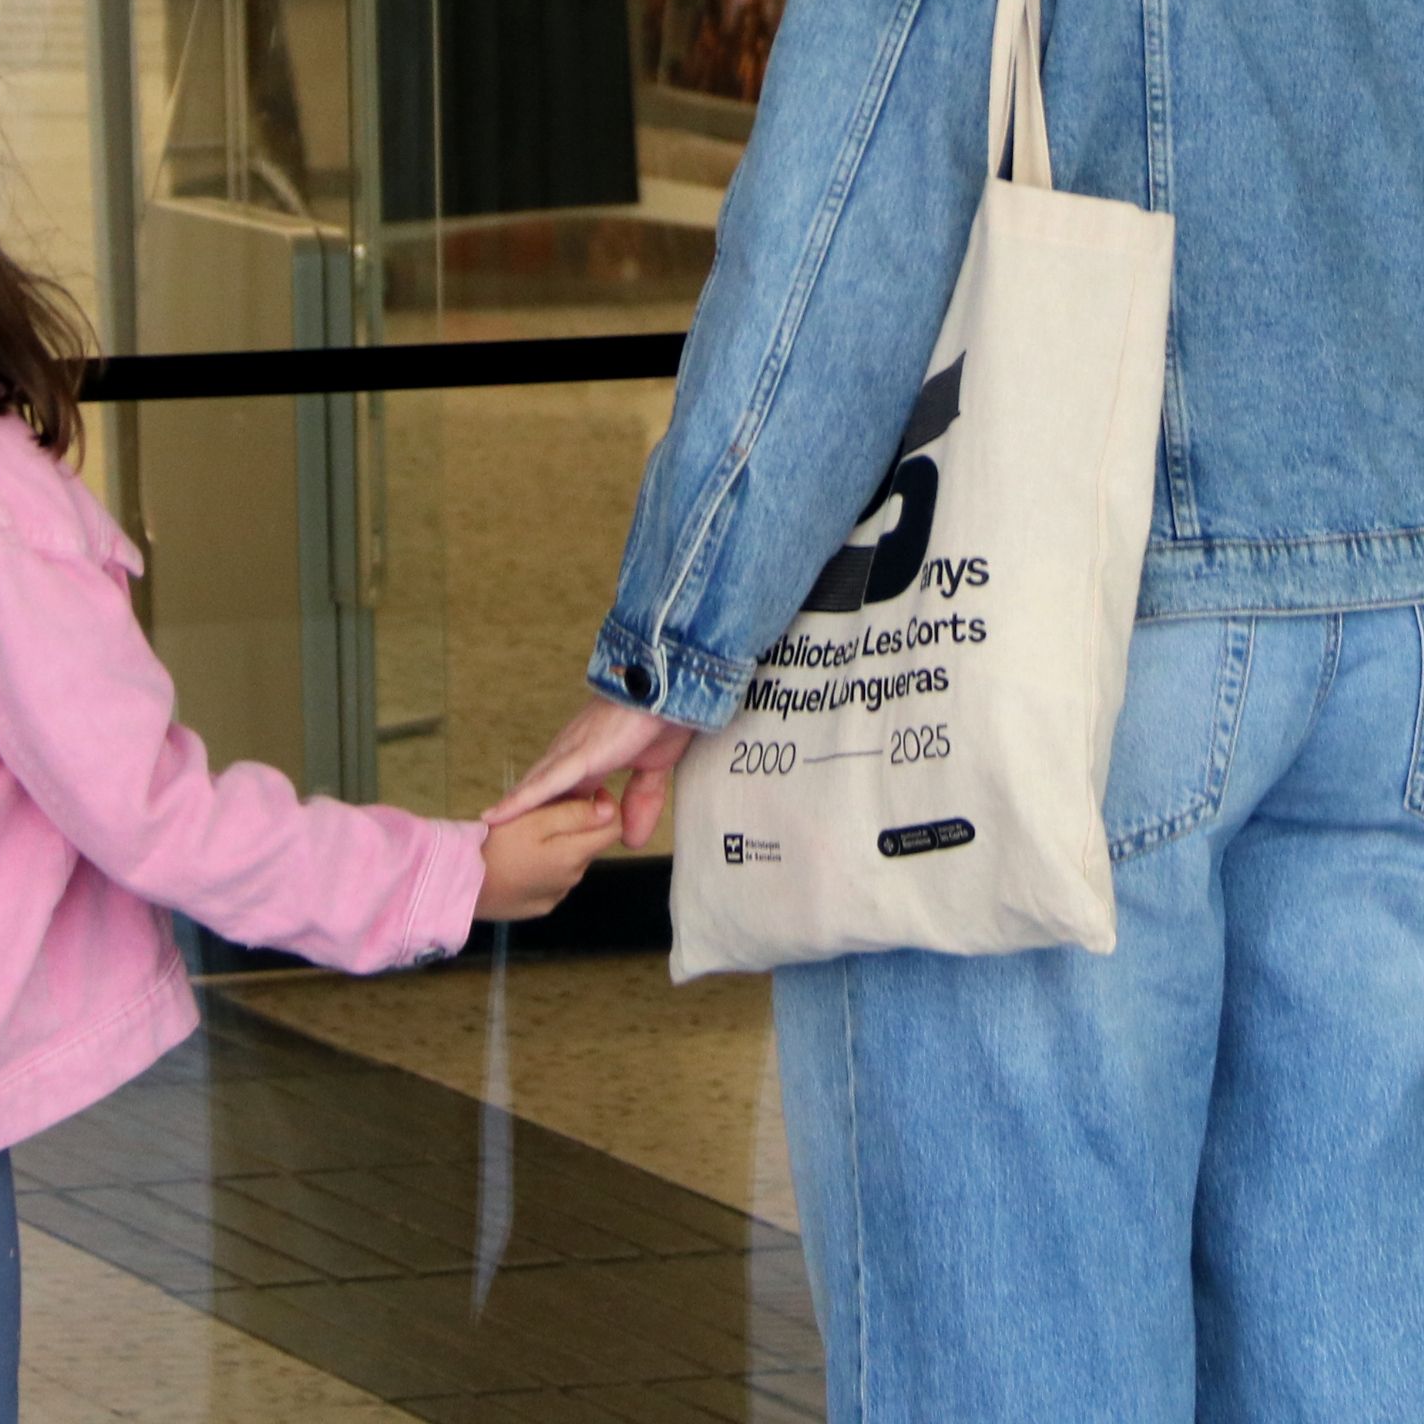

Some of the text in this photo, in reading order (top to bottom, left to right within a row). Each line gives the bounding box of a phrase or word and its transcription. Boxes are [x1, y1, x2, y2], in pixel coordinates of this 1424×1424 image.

[862, 627, 902, 656] Les
[907, 613, 987, 649] Corts
[745, 678, 828, 720] Miquel
[730, 724, 951, 775] 2000 2025
